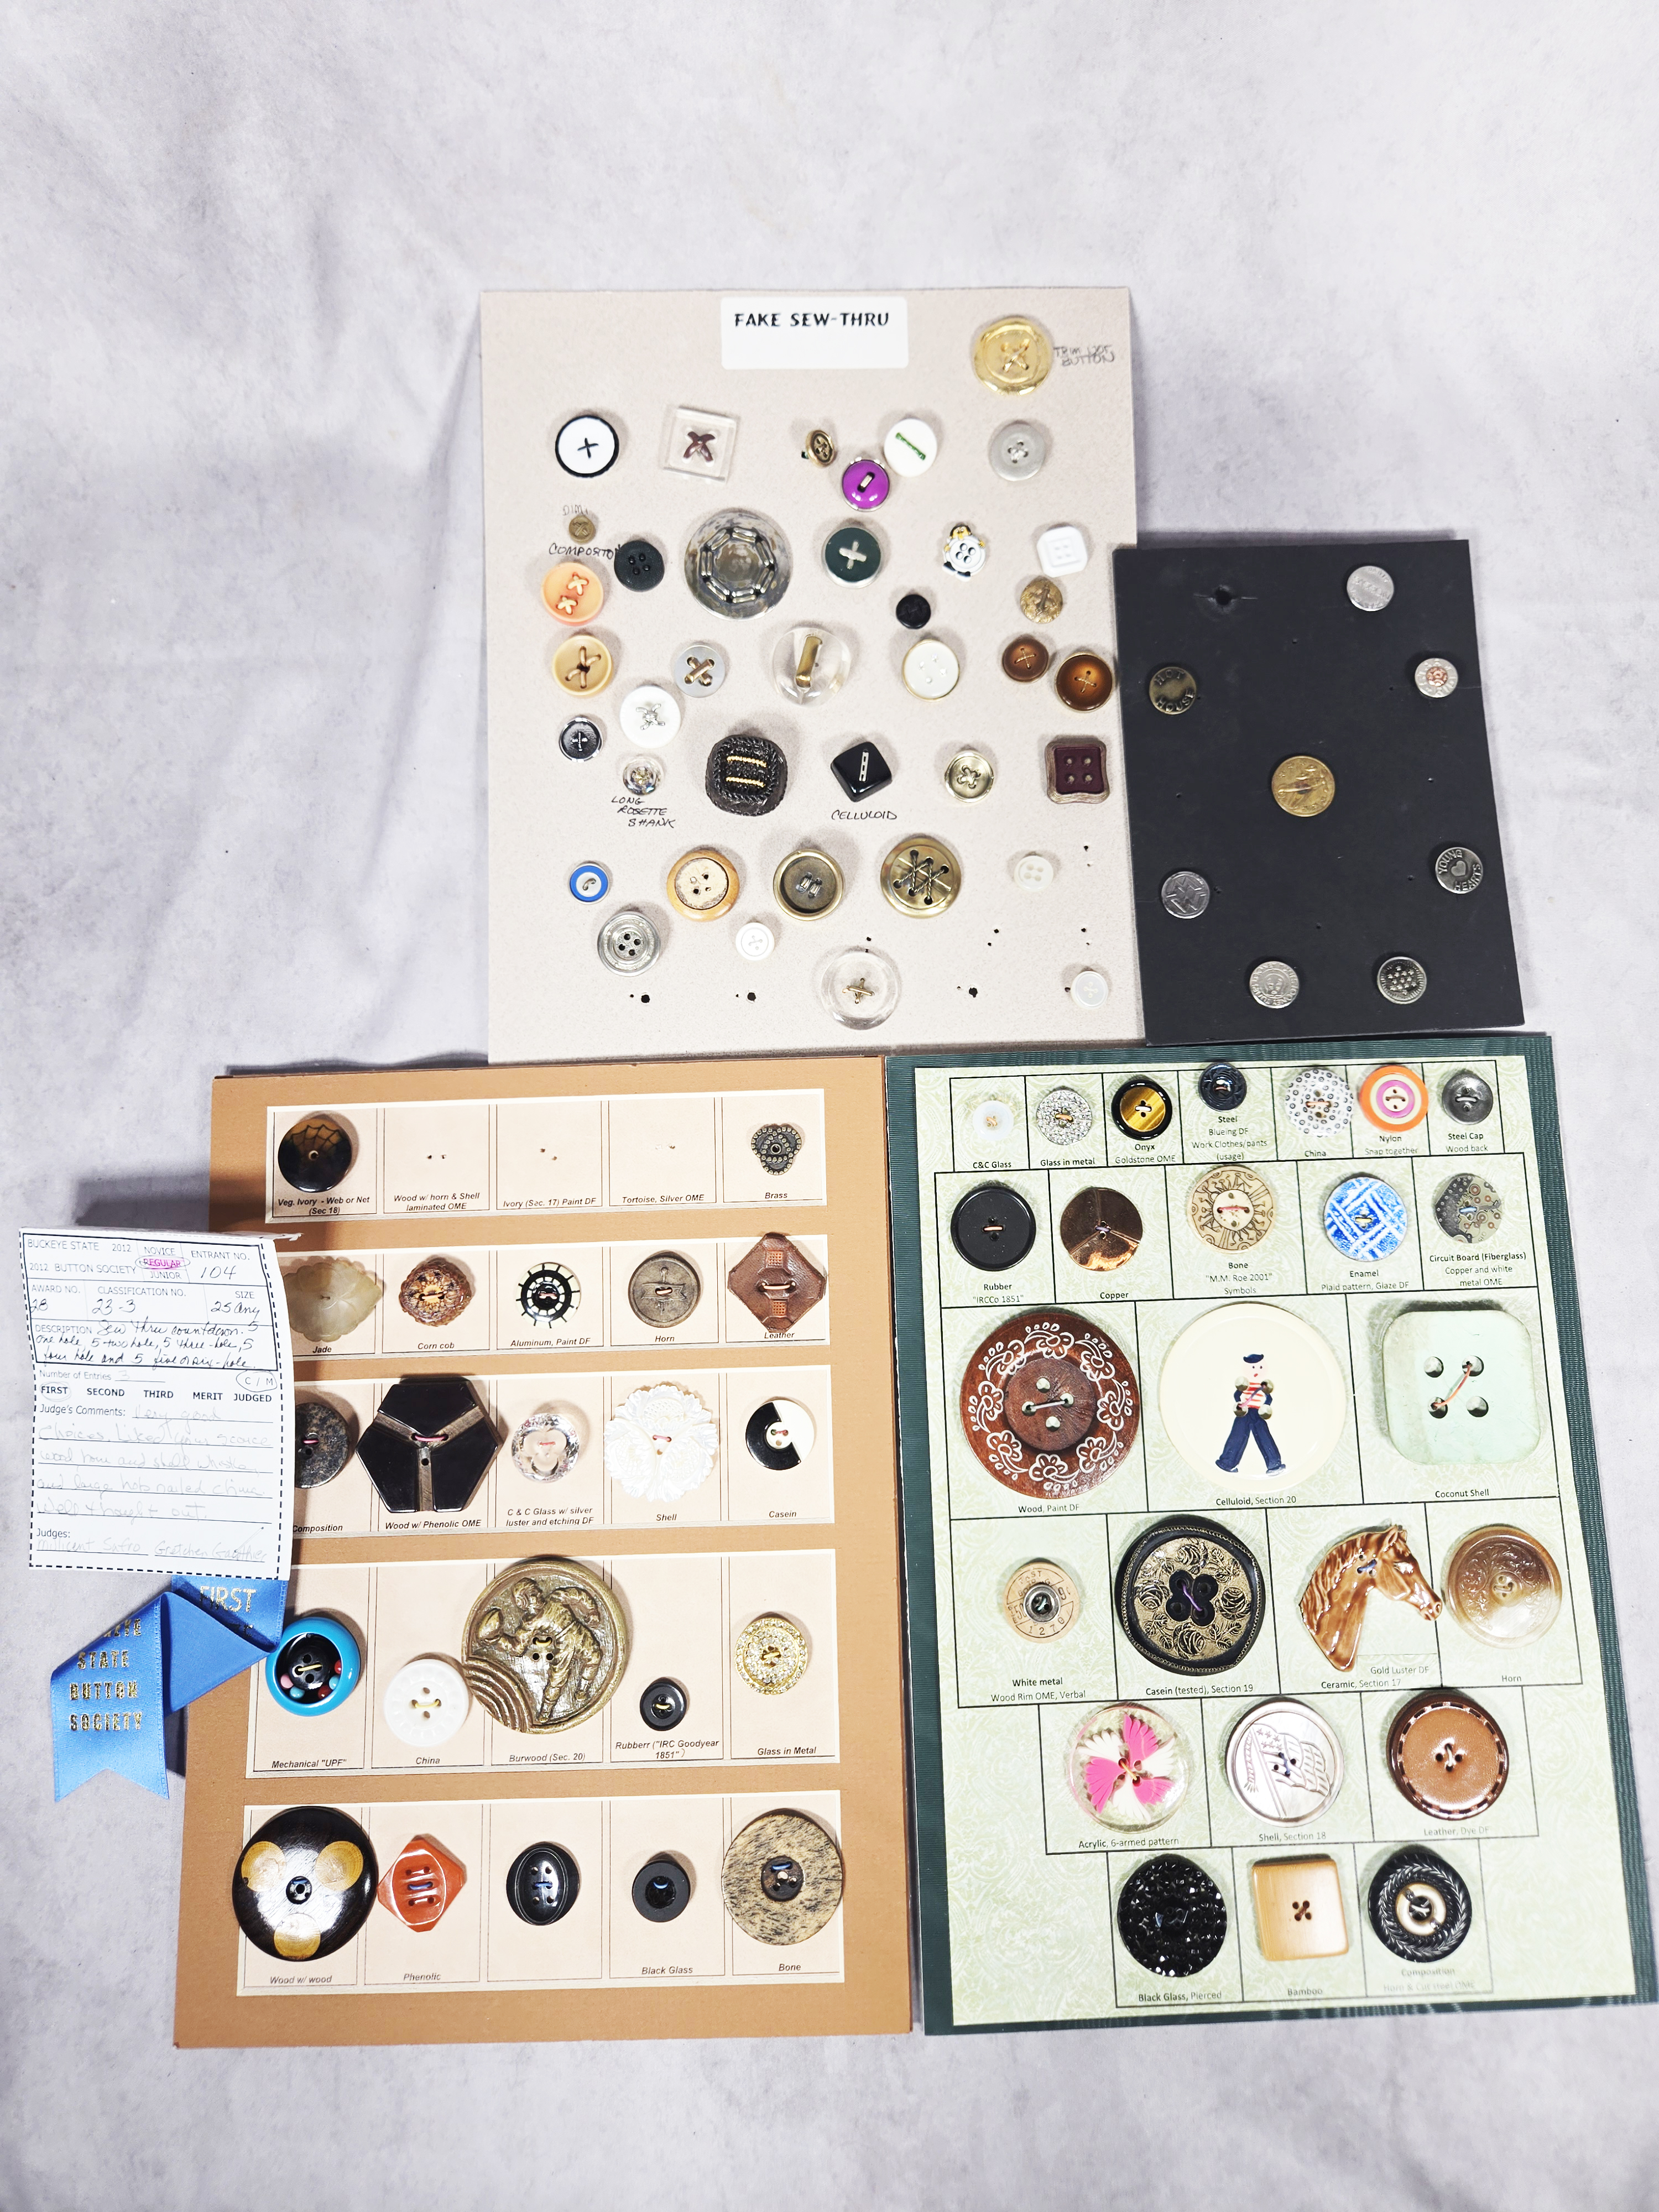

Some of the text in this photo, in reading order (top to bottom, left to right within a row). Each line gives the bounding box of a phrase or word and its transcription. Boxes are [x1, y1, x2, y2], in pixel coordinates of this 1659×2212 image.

[735, 313, 889, 326] FAKE SEW-THRU
[1062, 352, 1114, 366] BUTTON
[1154, 669, 1185, 685] HOT
[1156, 687, 1194, 712] HOUSE
[611, 796, 645, 805] LONG
[617, 805, 667, 815] ROSETTE
[832, 810, 897, 820] CELLULOID
[628, 818, 676, 828] SHANK
[1438, 849, 1463, 874] YOUNG
[1454, 864, 1481, 891] HEARTS
[28, 1239, 132, 1252] BUCKEYE STATE 2012
[145, 1246, 176, 1255] NOVICE
[191, 1250, 230, 1259] ENTRANT
[1481, 1252, 1526, 1261] (Fiberglass)
[143, 1258, 181, 1267] REGULAR
[30, 1262, 135, 1274] 2012 BUTTON SOCIETY
[201, 1265, 236, 1280] 104
[1445, 1267, 1473, 1275] Copper
[32, 1285, 61, 1293] AWARD
[98, 1286, 168, 1295] CLASSIFICATION
[1224, 1287, 1256, 1295] Symbols
[1100, 1292, 1129, 1301] Copper
[35, 1324, 92, 1334] DESCRIPTION
[91, 1338, 101, 1347] 5
[164, 1337, 171, 1347] 5
[131, 1354, 144, 1364] 5
[40, 1370, 111, 1380] Number Entries
[87, 1388, 125, 1396] SECOND
[144, 1390, 174, 1399] THIRD
[193, 1392, 223, 1400] MERIT
[233, 1394, 272, 1402] JUDGED
[76, 1406, 126, 1416] Comments:
[1435, 1490, 1469, 1498] Coconut
[1216, 1497, 1253, 1506] Celluloid,
[293, 1524, 343, 1533] Composition
[423, 1520, 459, 1528] Phenolic
[36, 1528, 70, 1538] Judges:
[1019, 1570, 1042, 1584] FAST
[200, 1585, 257, 1613] FIRST
[77, 1650, 129, 1670] STATE
[70, 1680, 138, 1700] BUTTON
[1146, 1687, 1173, 1695] Casein
[991, 1693, 1016, 1702] Wood
[1060, 1690, 1086, 1699] Verbal
[69, 1712, 142, 1731] SOCIETY
[678, 1740, 719, 1750] Goodyear
[272, 1760, 319, 1768] Mechanical
[416, 1756, 440, 1765] China
[1284, 1832, 1314, 1840] Section
[1111, 1838, 1179, 1846] 6-armed pattern
[779, 1963, 801, 1971] Bone
[270, 1976, 295, 1984] Wood
[404, 1973, 441, 1981] Phenolic
[1138, 1991, 1222, 2002] Black Pierced
[1288, 1987, 1323, 1996] Bamboo
